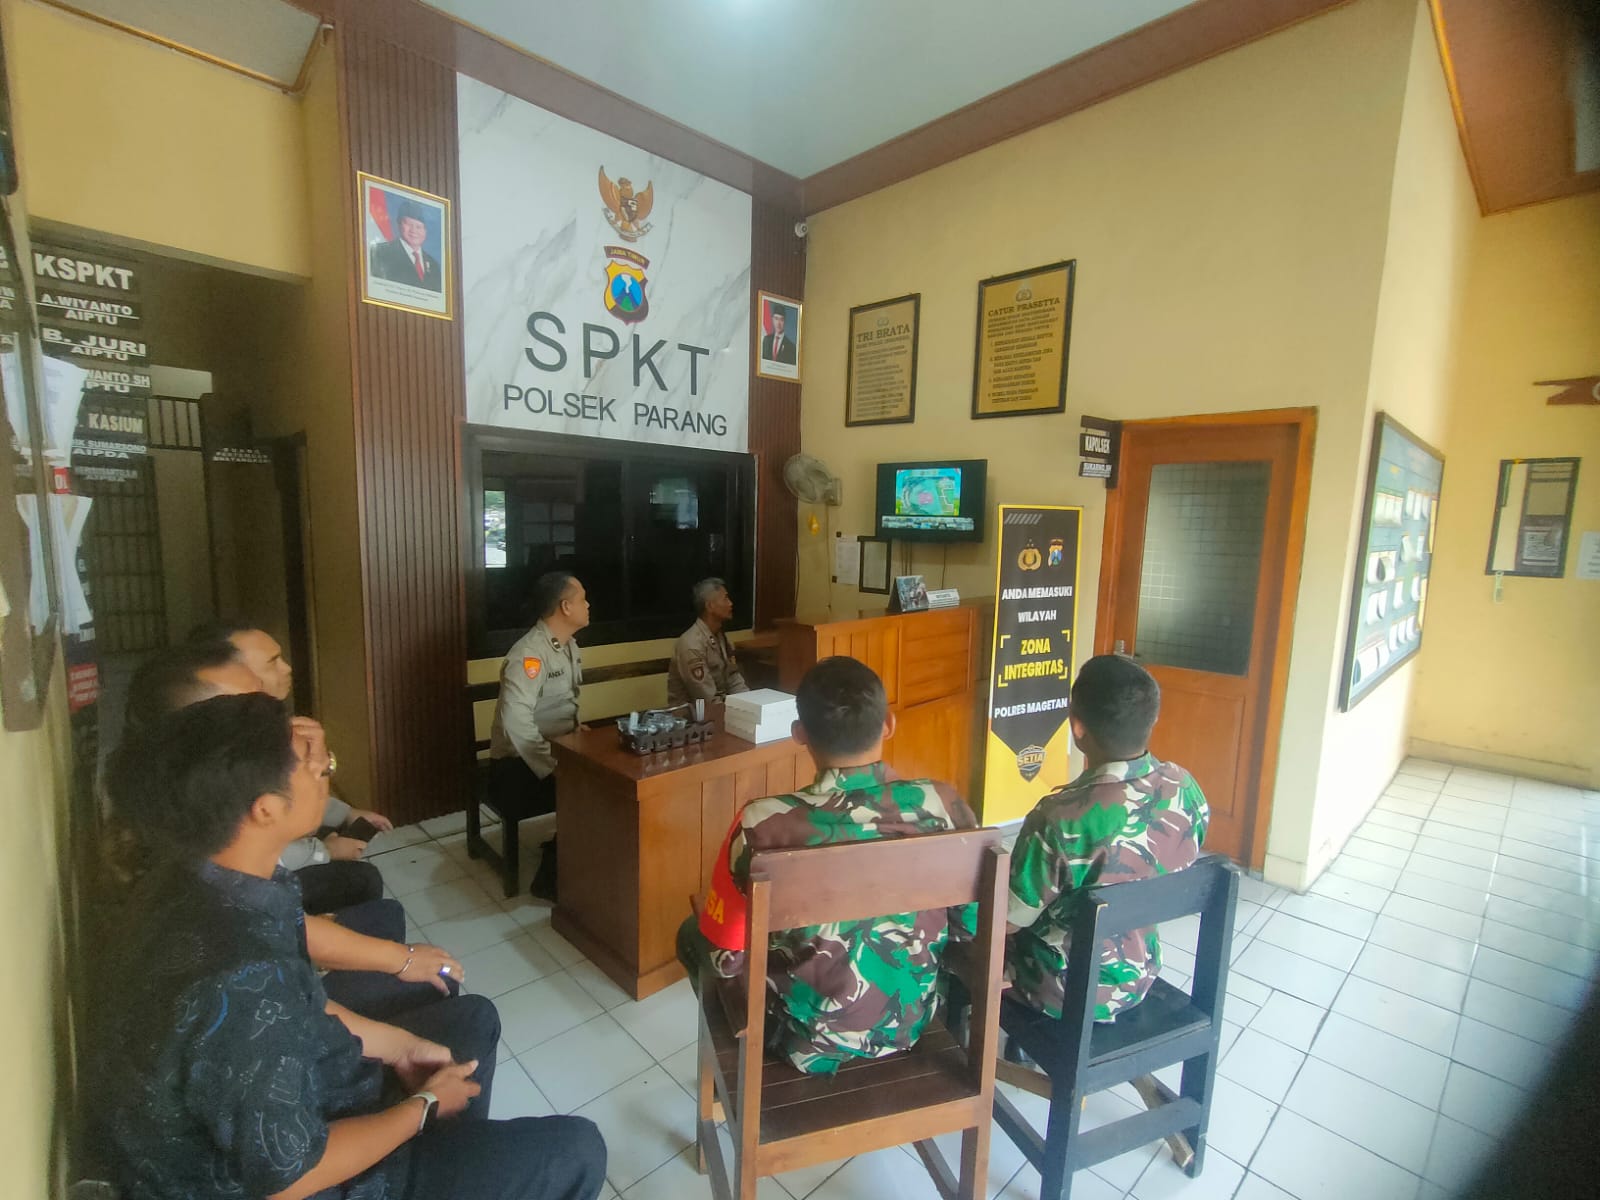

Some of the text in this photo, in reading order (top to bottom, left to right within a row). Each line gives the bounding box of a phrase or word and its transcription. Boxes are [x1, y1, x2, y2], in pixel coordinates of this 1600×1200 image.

[34, 253, 133, 290] KSPKT
[41, 293, 133, 316] A.WIYANTO
[988, 306, 1015, 317] CATUR
[65, 310, 118, 325] AIPTU
[42, 328, 147, 355] B. JURI
[856, 324, 910, 343] TRI BRATA
[70, 346, 128, 361] AIPTU
[525, 311, 710, 396] SPKT
[86, 381, 130, 393] PTU
[133, 374, 150, 387] SH
[503, 384, 727, 436] POLSEK PARANG
[88, 413, 143, 434] KASIUM
[72, 448, 129, 459] AIPDA
[1085, 435, 1111, 454] KAPOLSEK
[1001, 586, 1073, 600] ANDA MEMASUKI
[1018, 609, 1057, 623] WILAYAH
[1020, 638, 1051, 655] ZONA
[1004, 659, 1064, 680] INTEGRITAS
[994, 697, 1068, 718] POLRES MAGETAN
